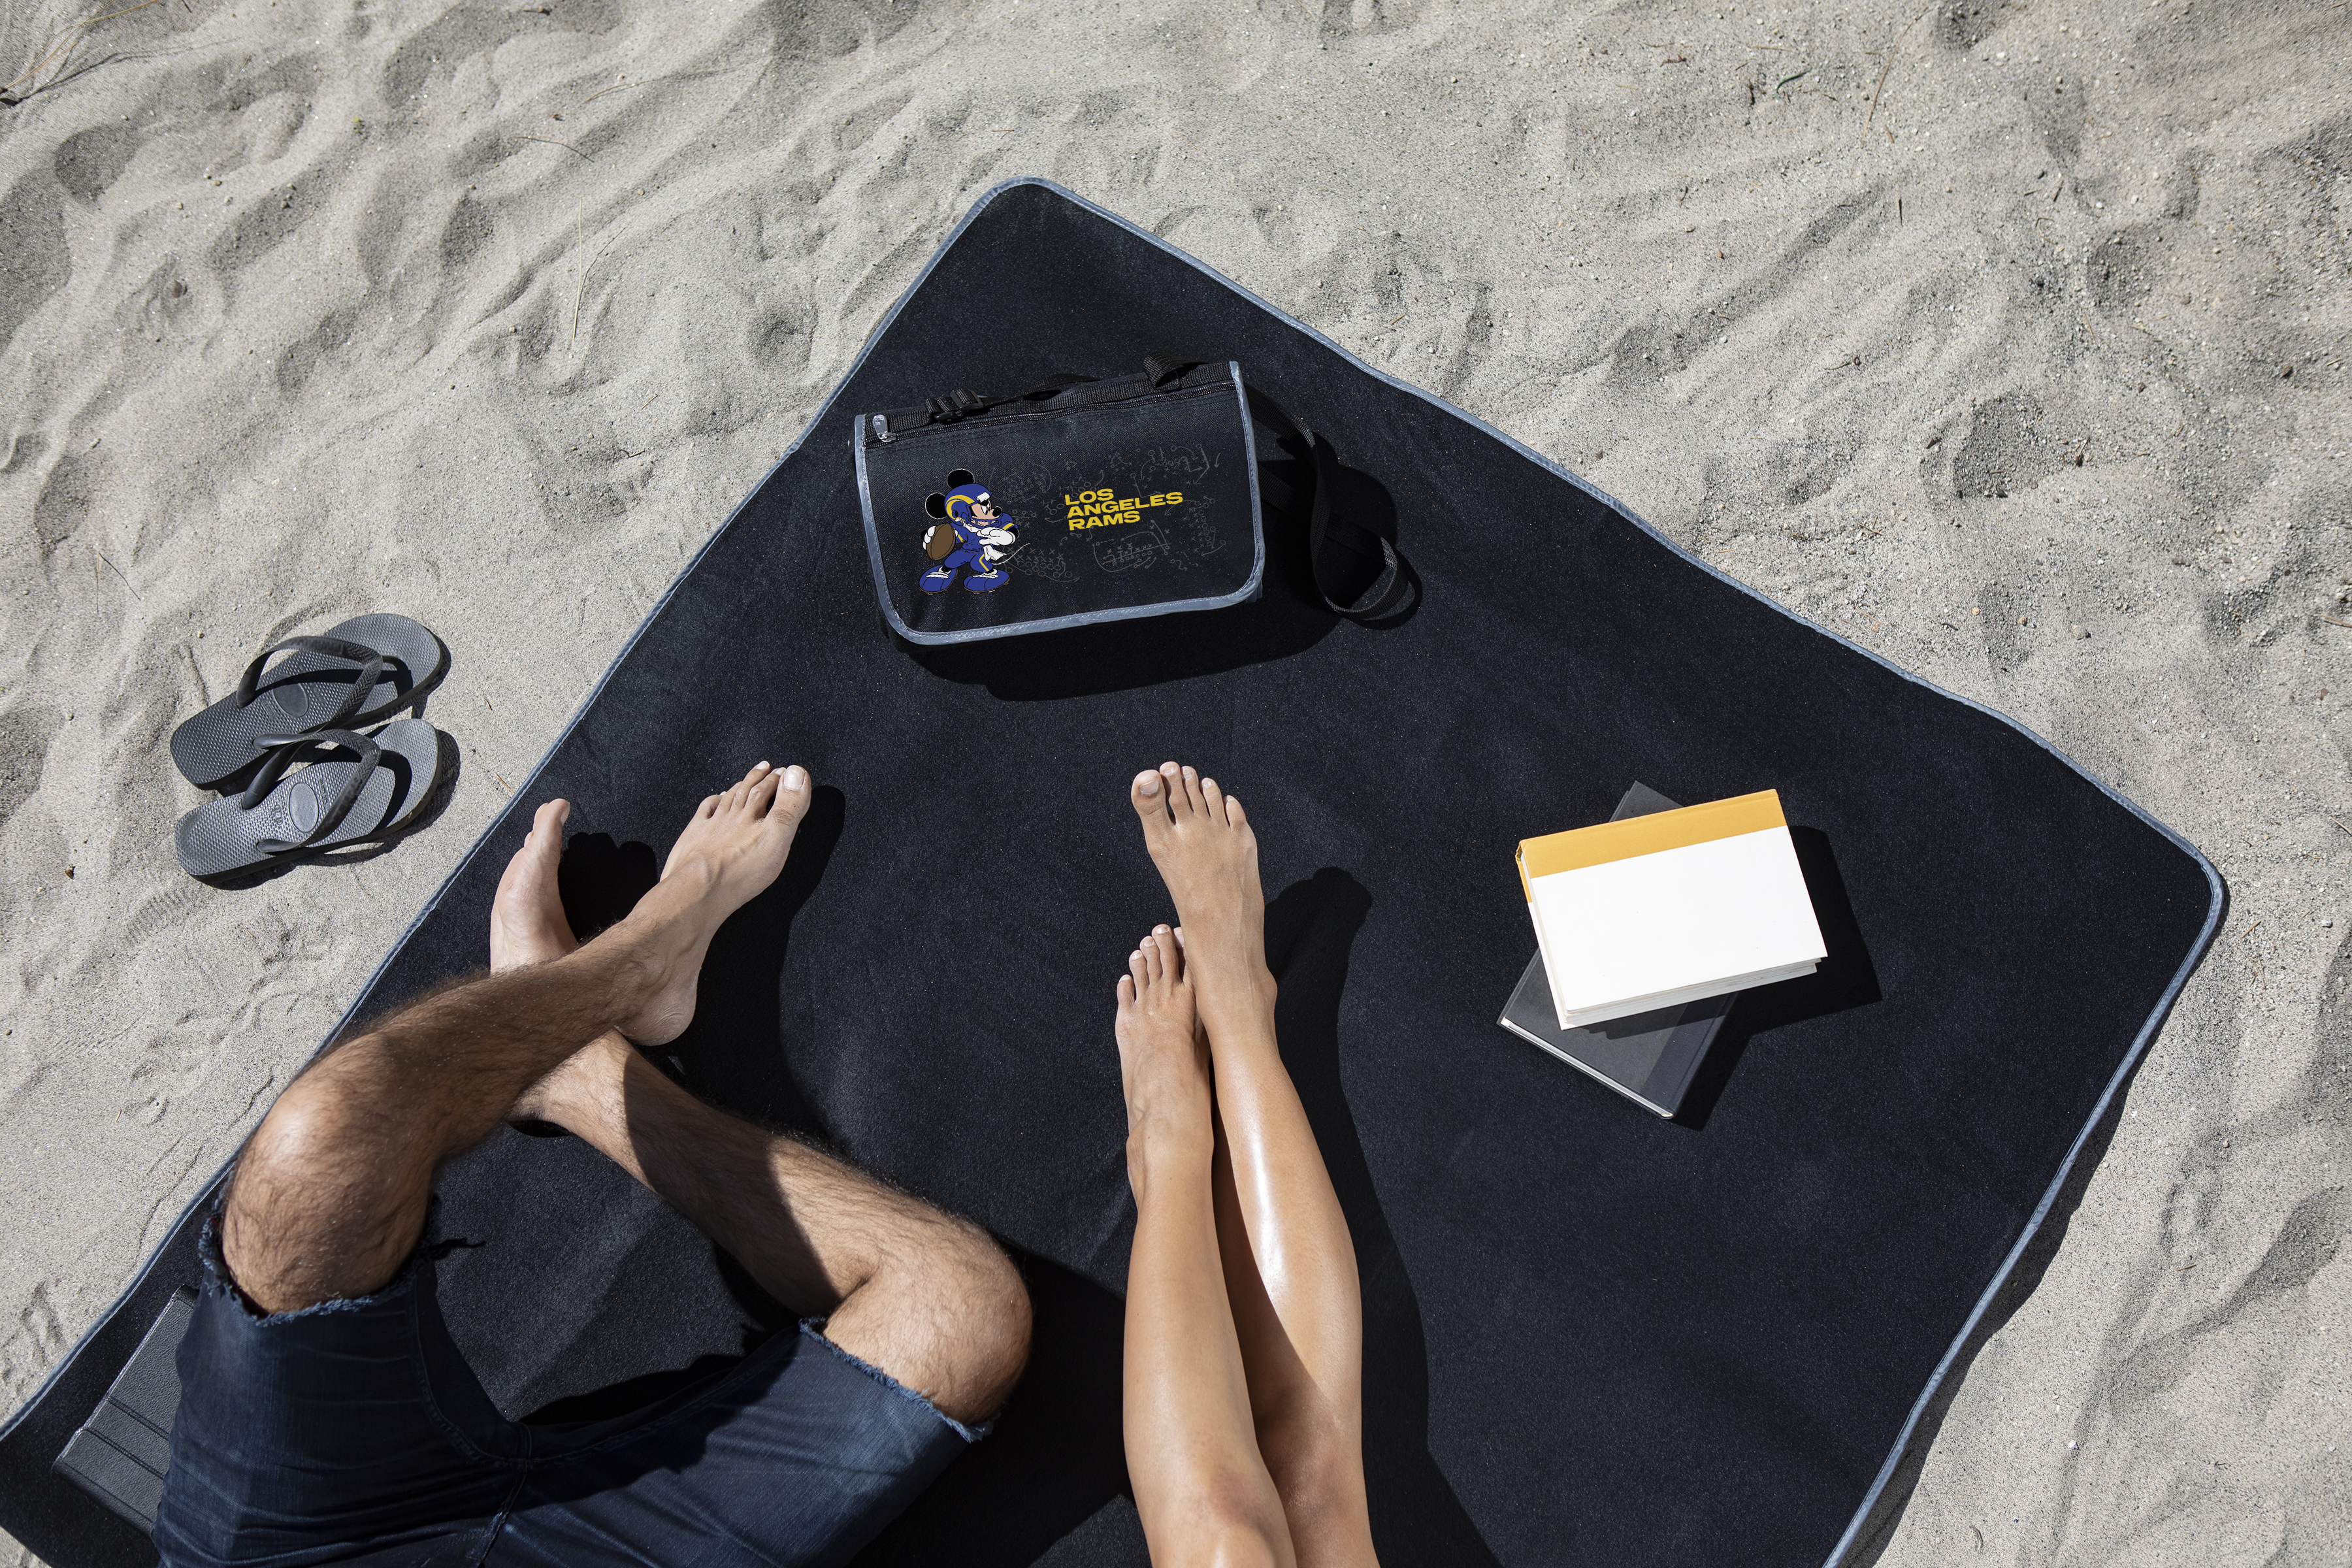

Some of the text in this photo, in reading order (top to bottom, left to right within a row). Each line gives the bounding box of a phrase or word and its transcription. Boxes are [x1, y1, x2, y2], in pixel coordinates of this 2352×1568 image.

[1064, 488, 1114, 506] LOS
[1066, 491, 1184, 519] ANGELES
[1068, 510, 1141, 531] RAMS
